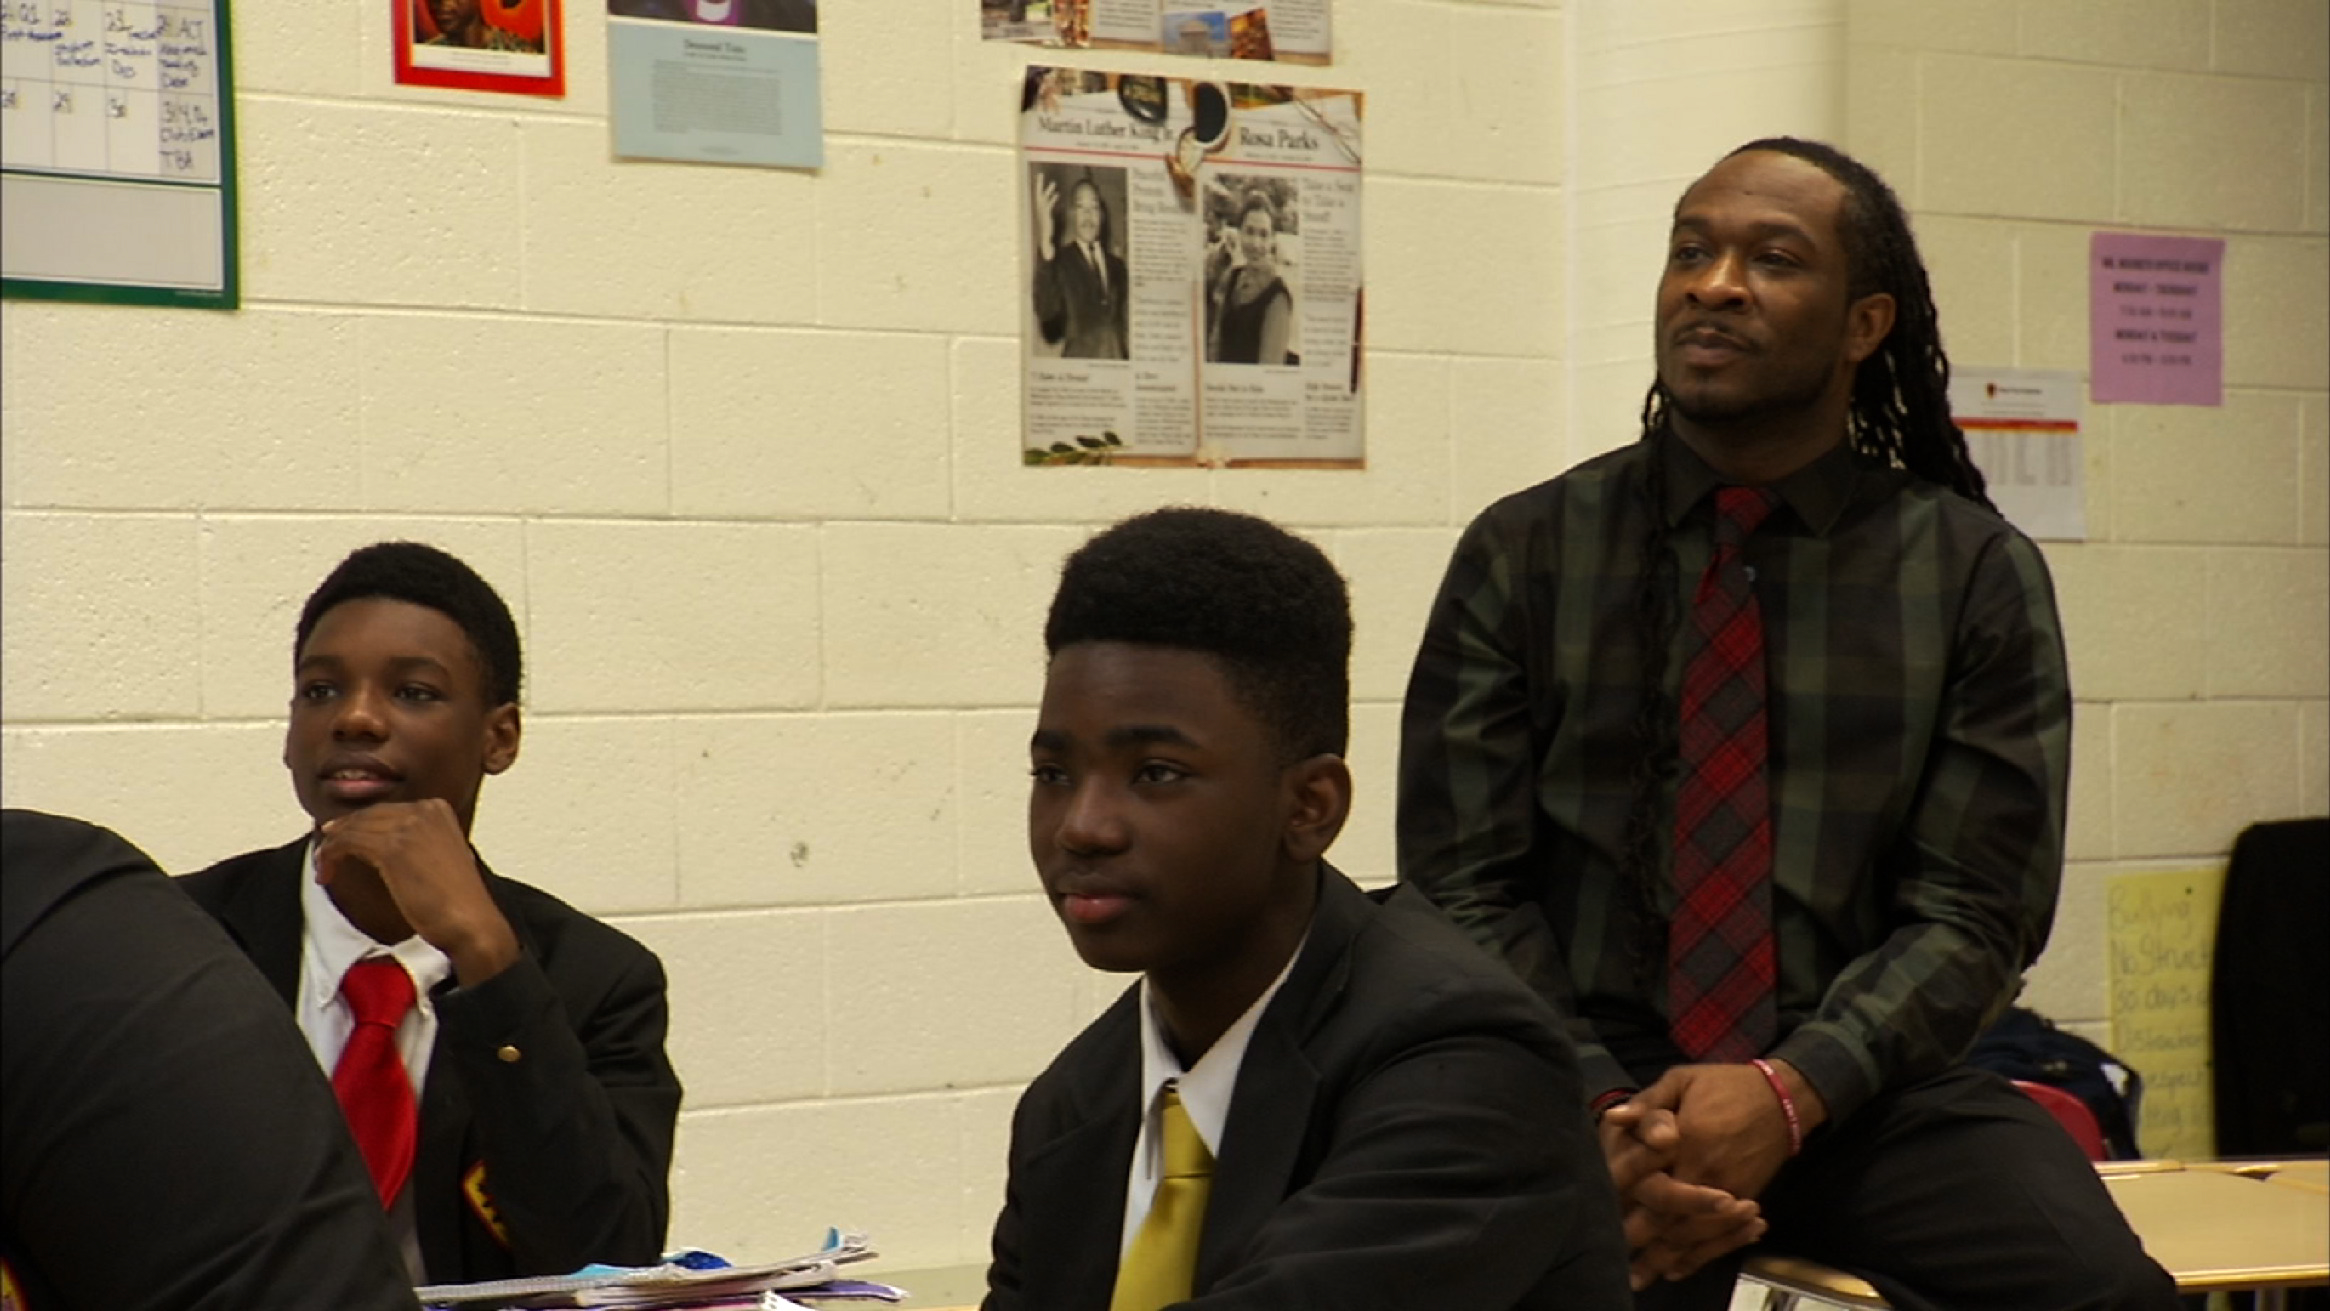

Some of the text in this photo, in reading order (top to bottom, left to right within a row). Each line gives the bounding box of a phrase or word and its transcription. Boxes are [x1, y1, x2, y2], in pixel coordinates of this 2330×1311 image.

[1037, 116, 1083, 134] Martin
[1086, 119, 1126, 136] Luther
[1240, 127, 1318, 150] Rosa Parks
[2109, 886, 2190, 938] Bullying
